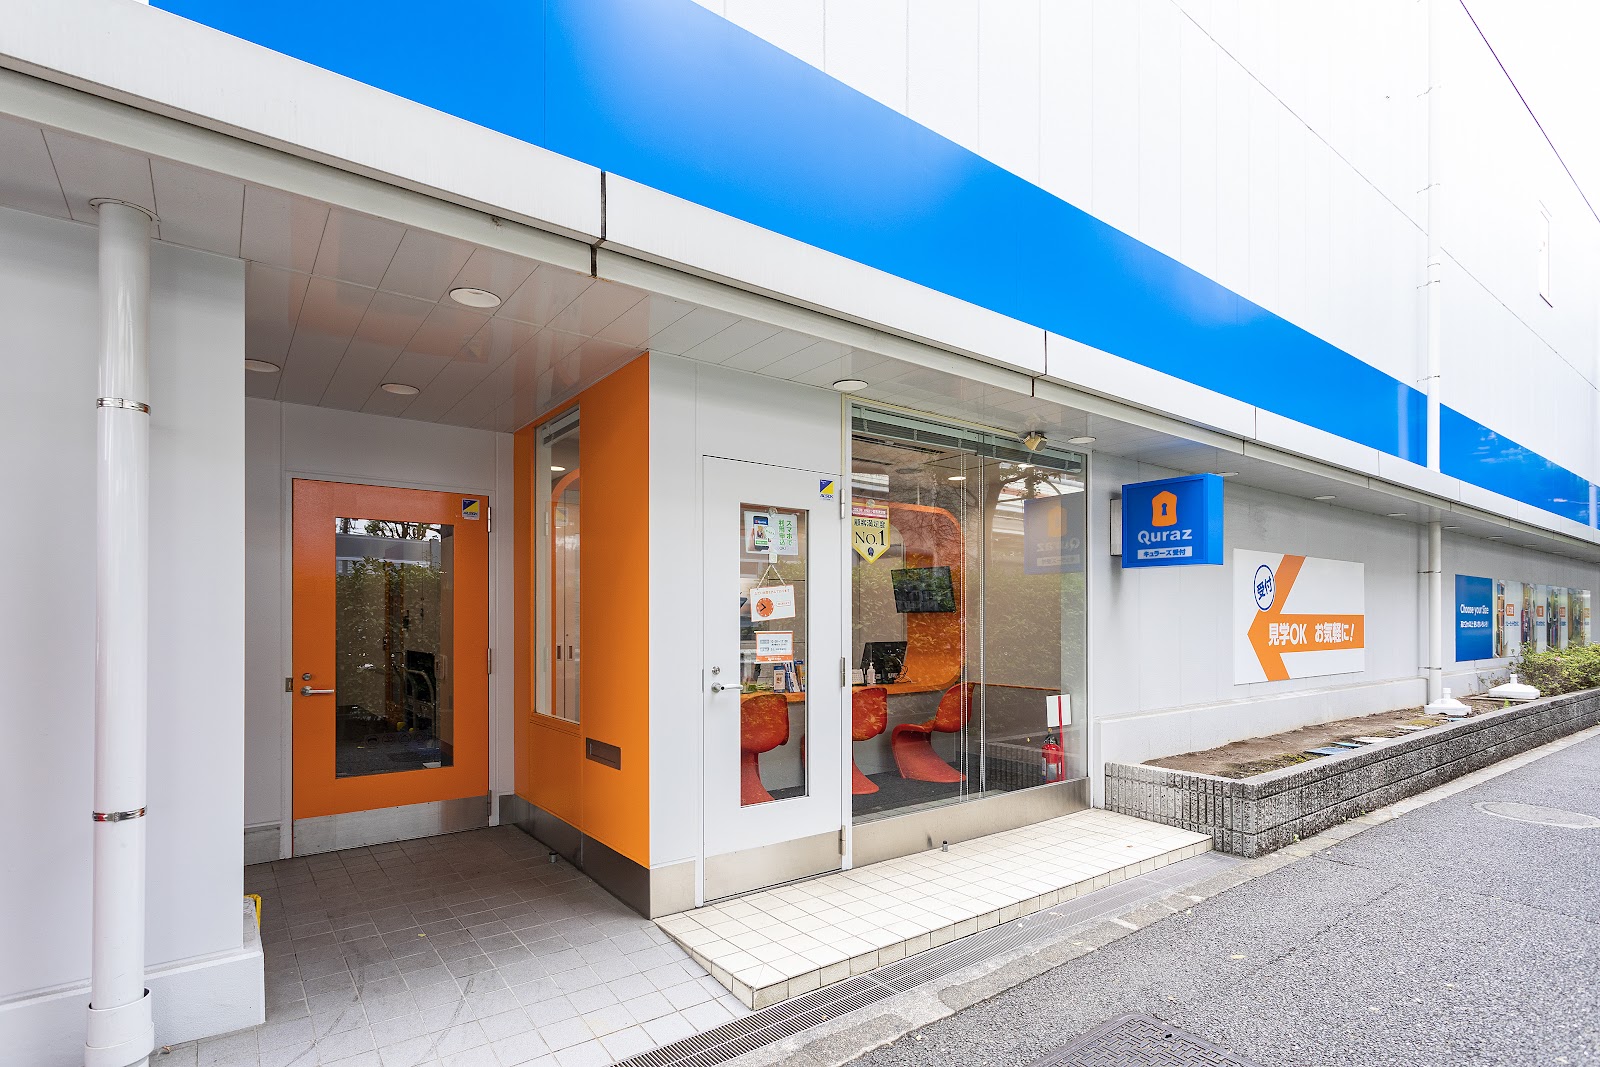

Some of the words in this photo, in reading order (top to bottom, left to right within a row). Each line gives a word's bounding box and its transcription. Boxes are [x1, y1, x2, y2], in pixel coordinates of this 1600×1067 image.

[1137, 529, 1193, 545] Quraz
[1143, 549, 1186, 557] キュラーズ受付
[1256, 575, 1273, 601] 受付
[1268, 623, 1308, 646] 見学OK
